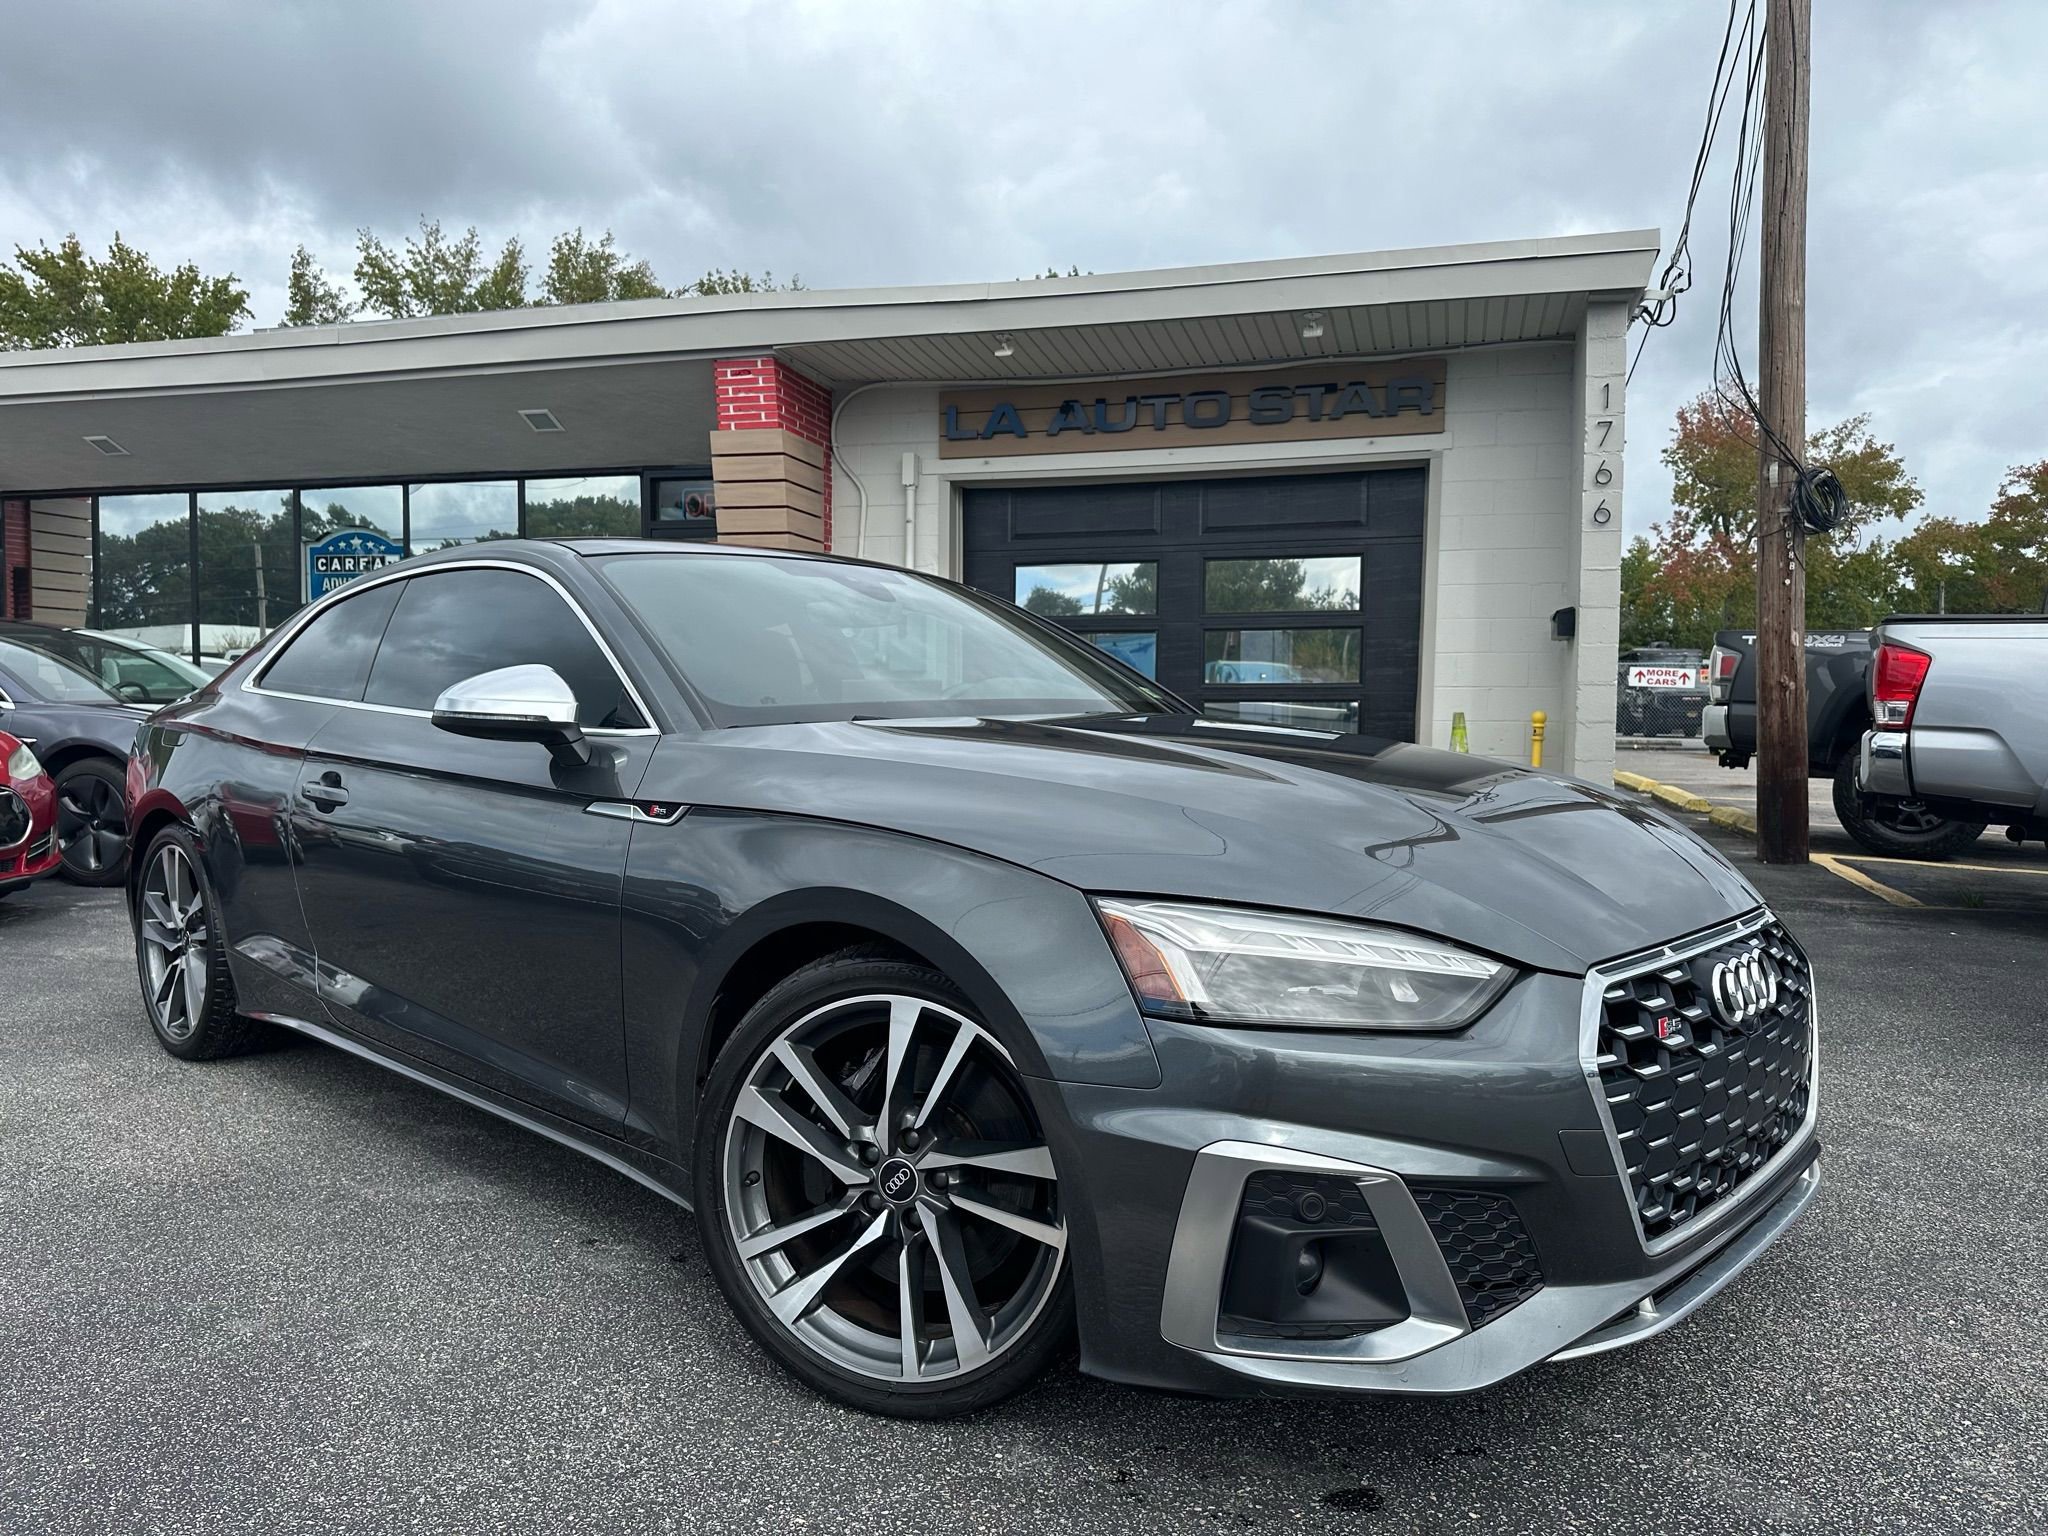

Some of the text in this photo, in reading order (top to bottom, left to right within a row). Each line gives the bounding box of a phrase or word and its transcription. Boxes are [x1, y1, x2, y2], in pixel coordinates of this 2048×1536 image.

[946, 378, 1433, 441] LA AUTO STAR
[1593, 382, 1613, 525] 1766
[1646, 669, 1679, 677] MORE
[1646, 678, 1677, 686] CARS
